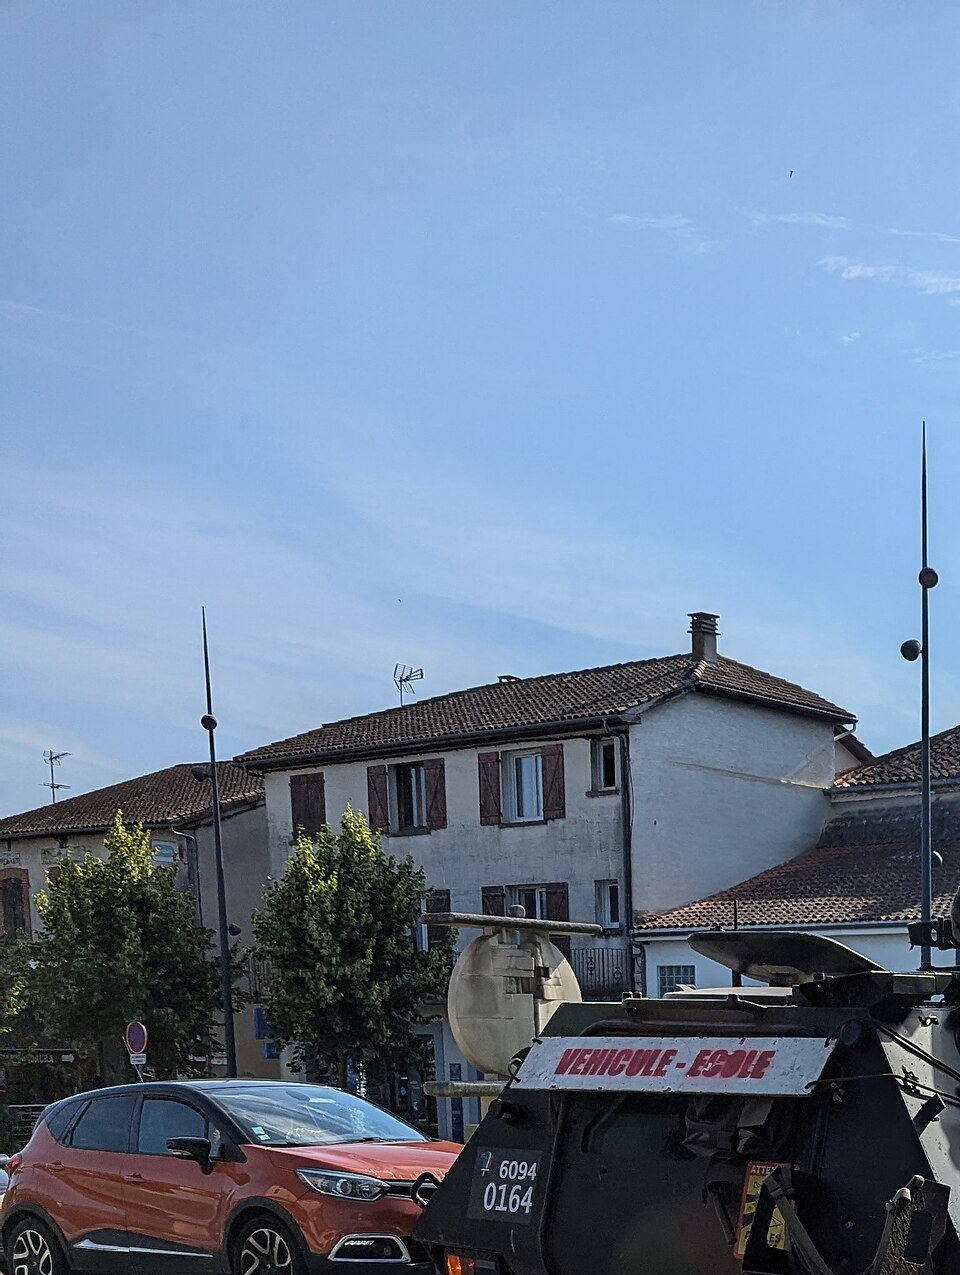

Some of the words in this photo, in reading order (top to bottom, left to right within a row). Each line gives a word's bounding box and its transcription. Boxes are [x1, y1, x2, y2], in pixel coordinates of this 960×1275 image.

[554, 1048, 679, 1077] VEHICULE
[685, 1050, 777, 1079] ECOLE
[499, 1160, 537, 1181] 6094
[483, 1182, 534, 1214] 0164
